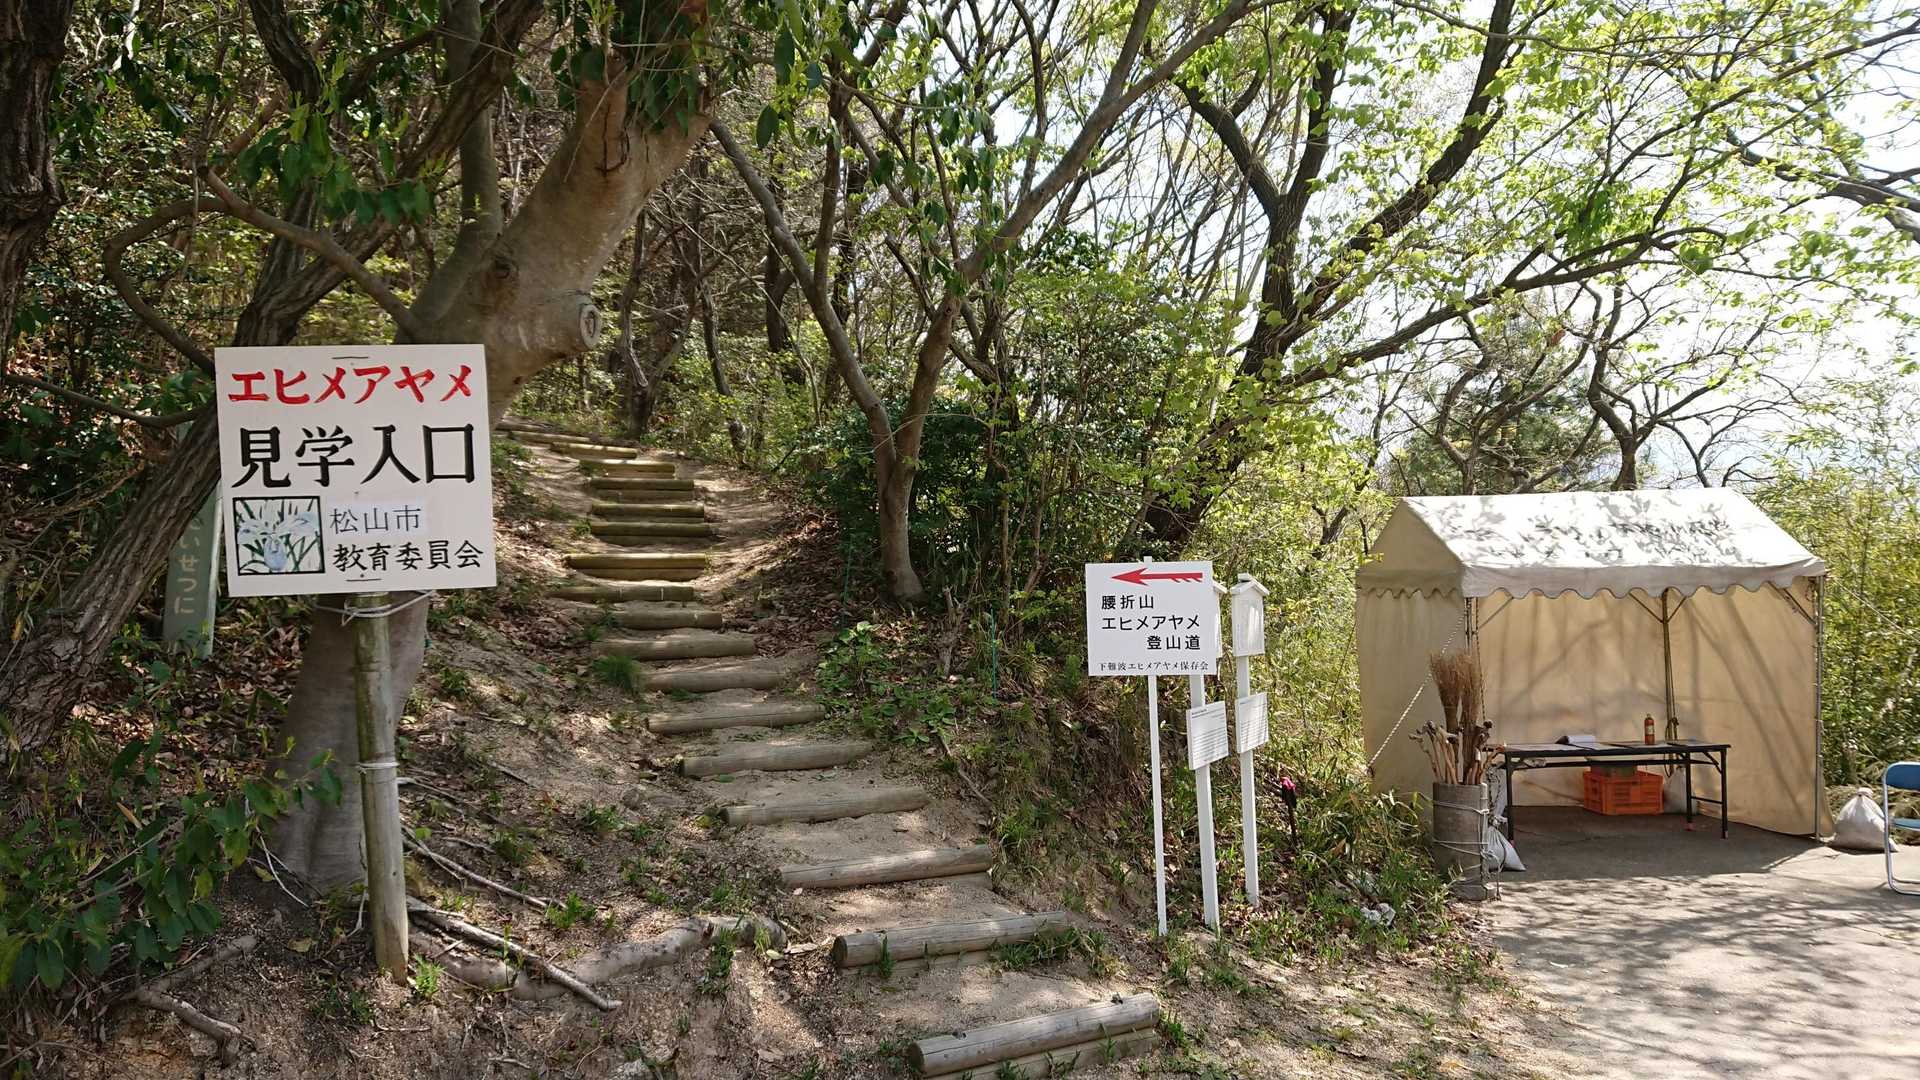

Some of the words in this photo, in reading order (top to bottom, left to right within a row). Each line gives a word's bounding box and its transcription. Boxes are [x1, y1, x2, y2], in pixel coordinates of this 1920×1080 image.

[228, 365, 472, 405] エヒメアヤメ
[232, 423, 476, 488] 見学入口
[329, 504, 422, 535] 松山市
[332, 539, 484, 572] 教育委員会
[1101, 594, 1154, 610] 腰折山
[1101, 614, 1200, 631] エヒメアヤメ
[1147, 634, 1201, 650] 登山道
